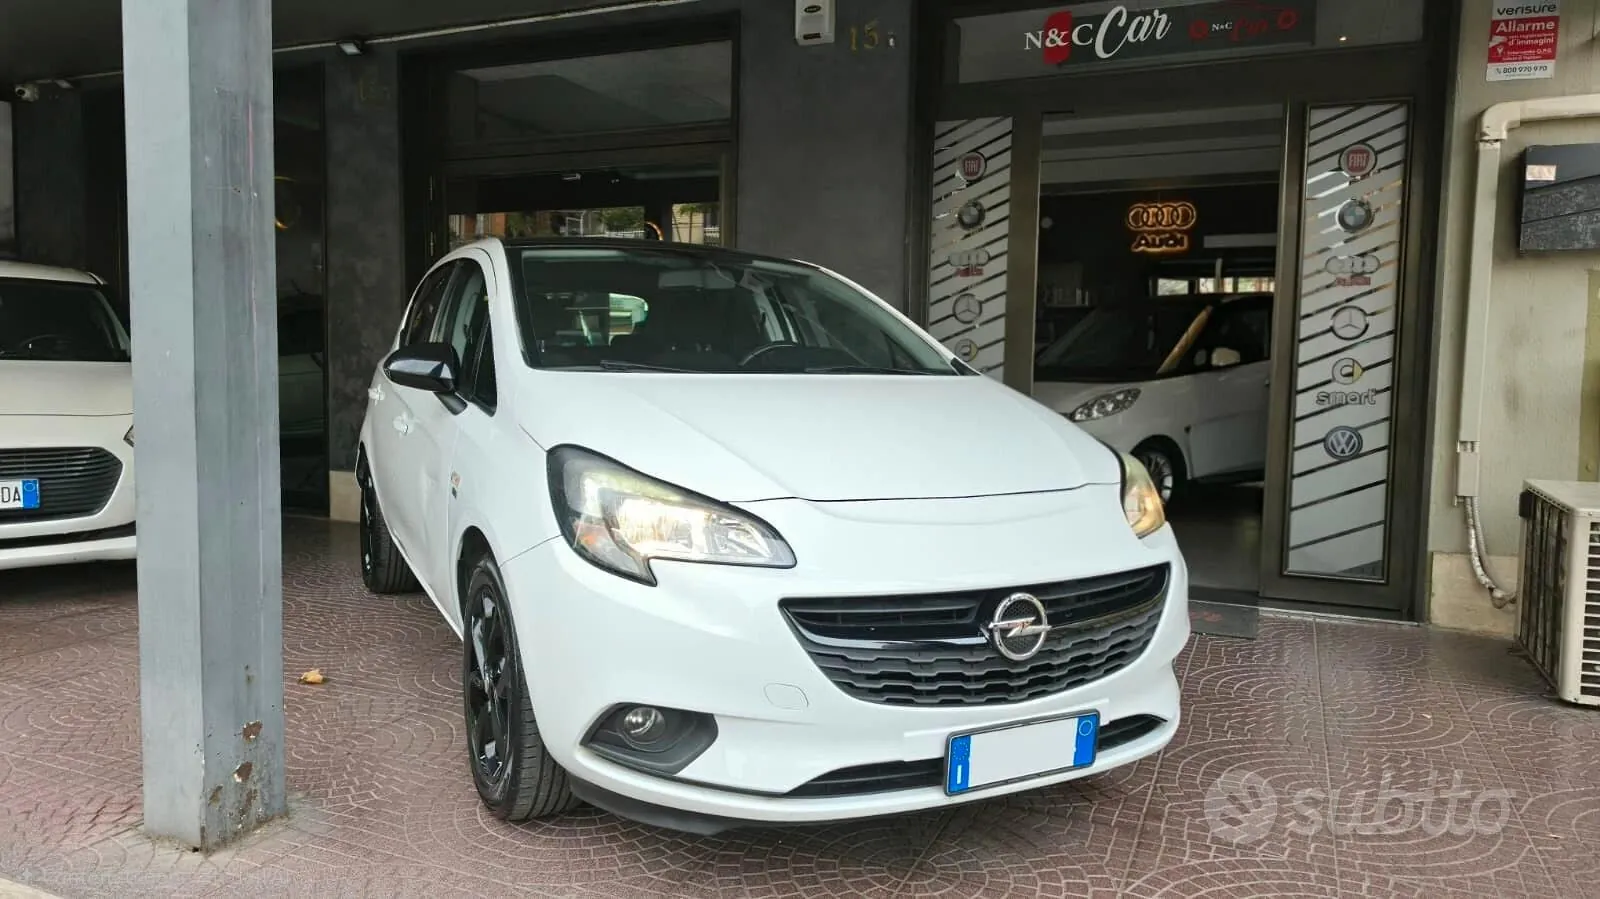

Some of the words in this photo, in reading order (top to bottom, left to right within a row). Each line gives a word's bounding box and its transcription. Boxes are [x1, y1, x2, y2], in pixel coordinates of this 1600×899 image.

[1497, 3, 1556, 15] verisure
[1024, 23, 1093, 50] N&C
[1095, 6, 1172, 58] Car
[1495, 20, 1555, 33] Allarme
[1508, 37, 1554, 46] d'immagini
[1316, 388, 1376, 405] smart
